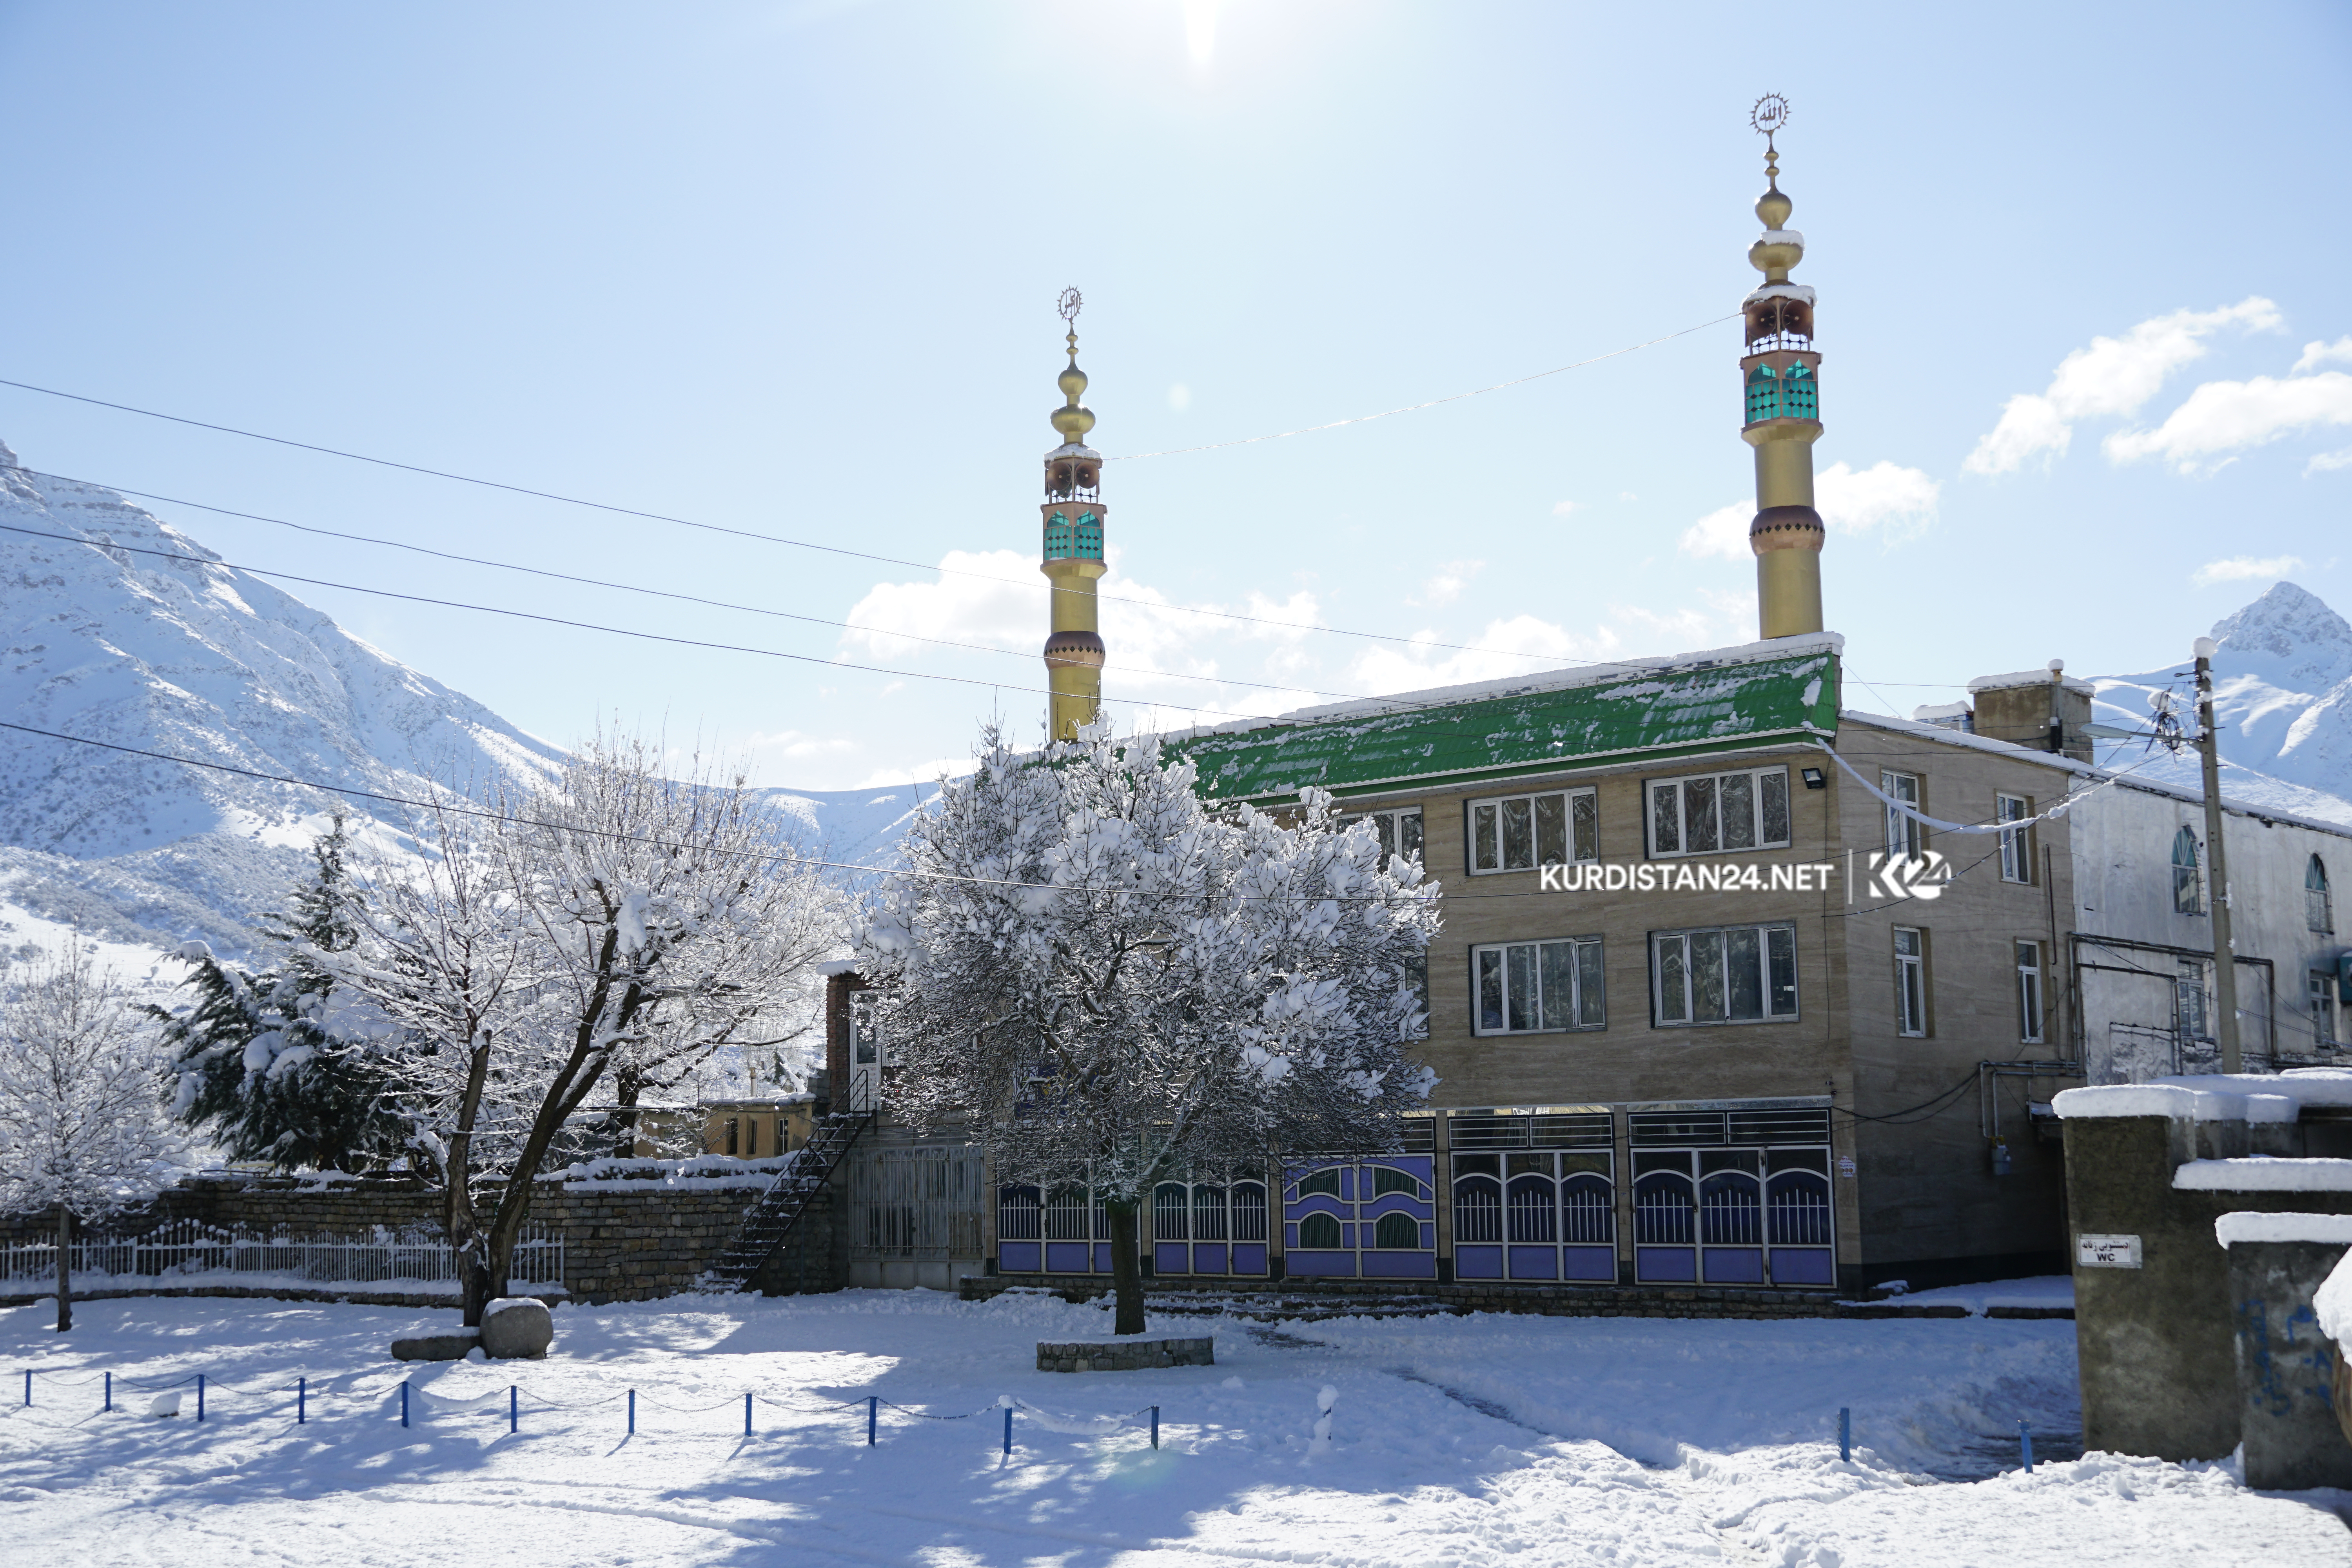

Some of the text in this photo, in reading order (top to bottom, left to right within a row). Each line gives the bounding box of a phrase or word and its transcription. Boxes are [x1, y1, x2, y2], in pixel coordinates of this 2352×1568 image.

[1760, 103, 1782, 122] الله
[2082, 1240, 2097, 1251] زنانه
[2097, 1253, 2115, 1261] WC
